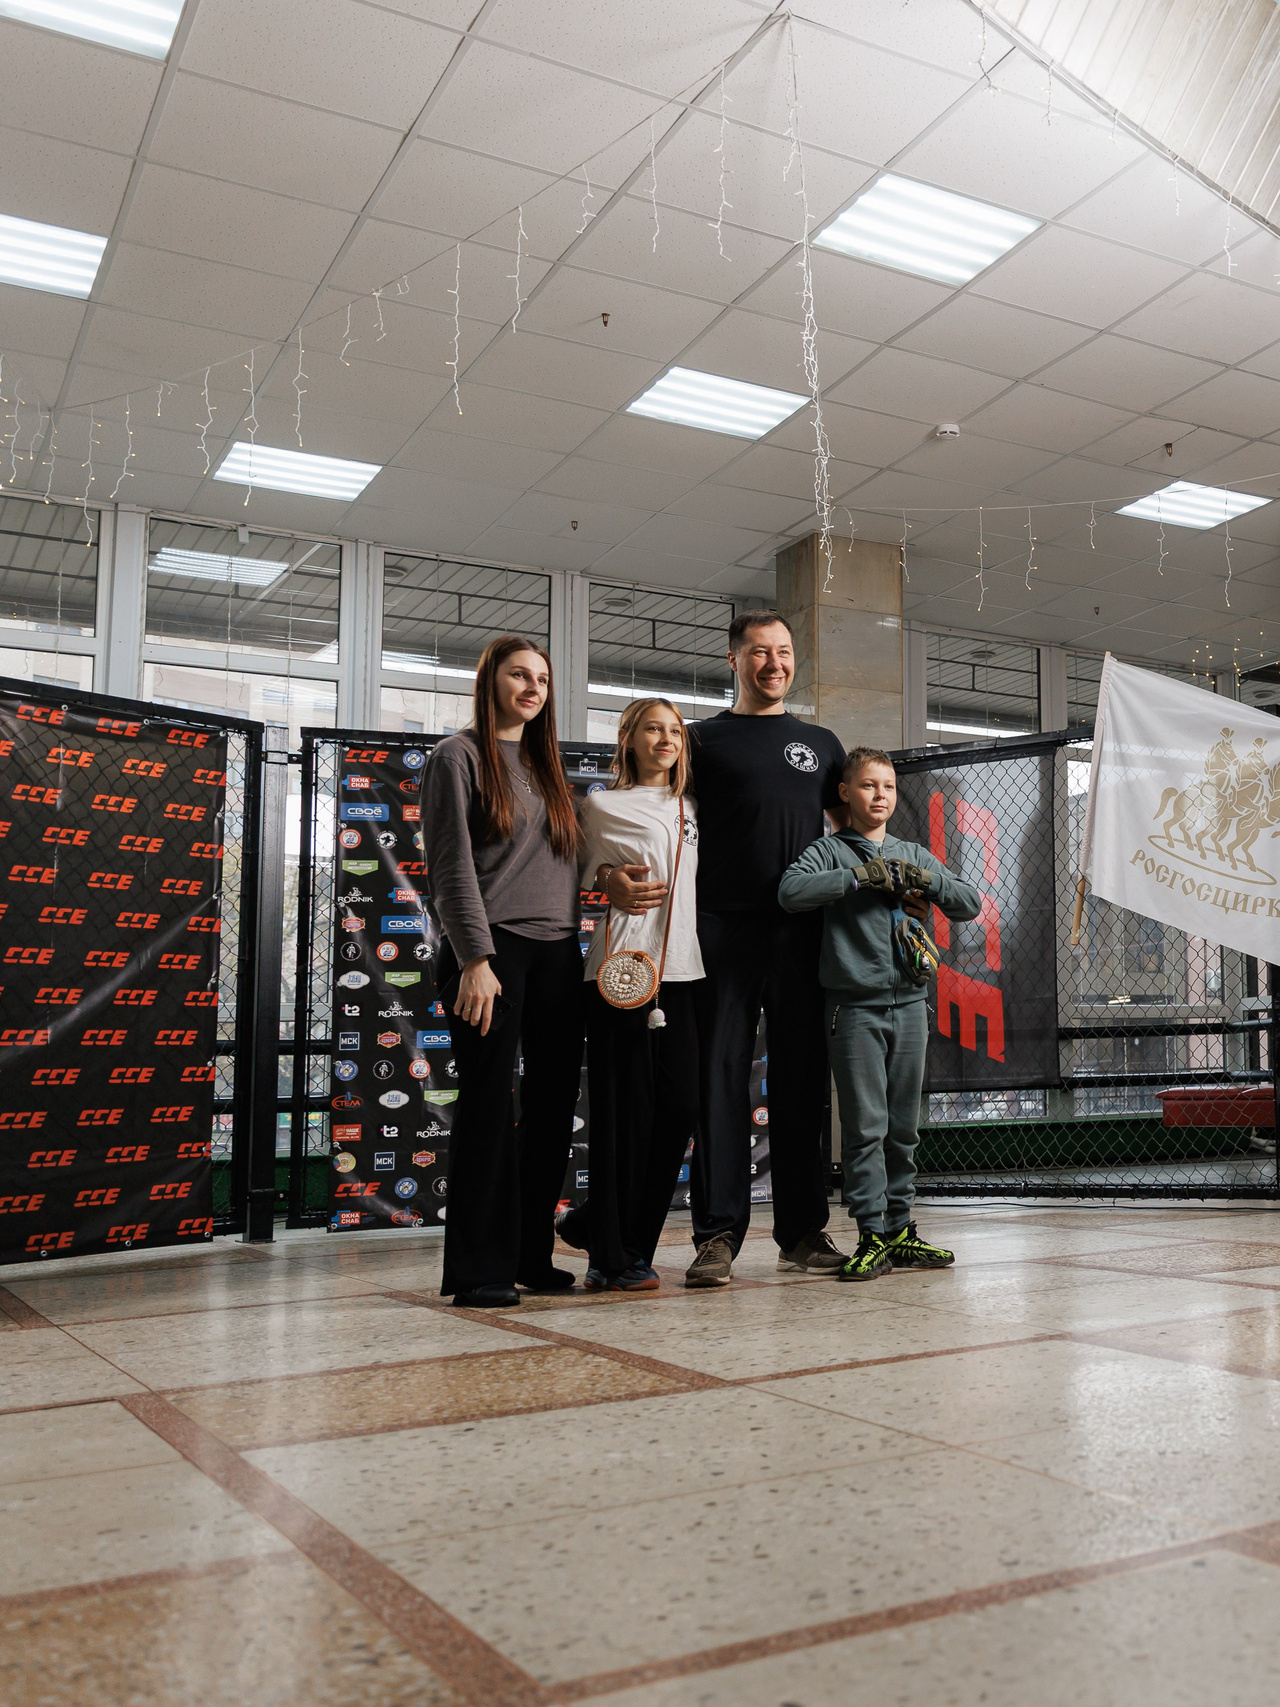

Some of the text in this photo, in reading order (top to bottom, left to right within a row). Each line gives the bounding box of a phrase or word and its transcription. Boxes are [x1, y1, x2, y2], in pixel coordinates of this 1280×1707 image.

[378, 1010, 414, 1018] RODNIK
[423, 1035, 452, 1043] СВО
[416, 1129, 451, 1138] RODNIK
